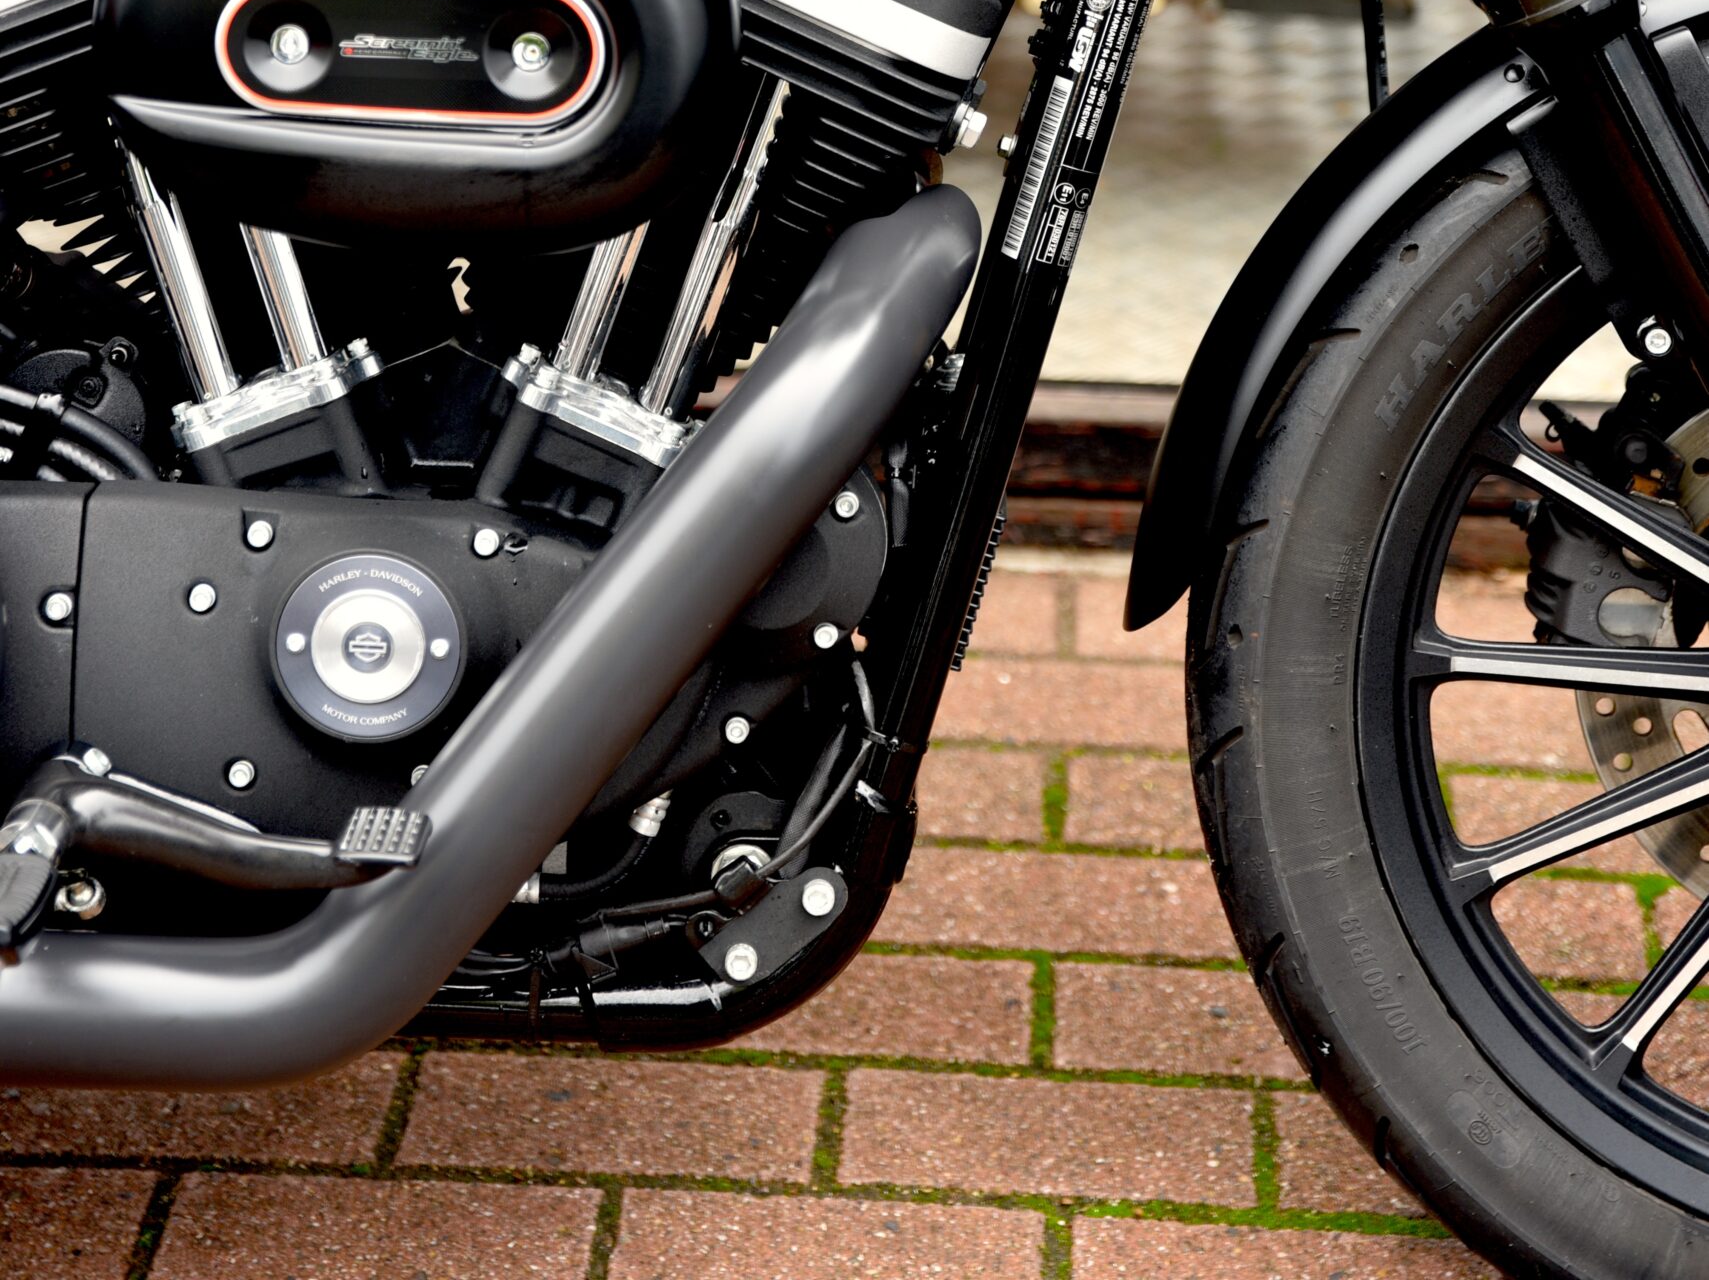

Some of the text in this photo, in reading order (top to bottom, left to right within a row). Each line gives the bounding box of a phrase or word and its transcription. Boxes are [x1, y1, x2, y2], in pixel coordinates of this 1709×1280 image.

[1115, 0, 1125, 12] kW
[1125, 2, 1134, 14] kW
[1104, 12, 1121, 47] VARIANT
[1114, 15, 1131, 49] VARIANT
[407, 47, 479, 63] Eagle
[1092, 58, 1106, 80] dB(A)
[1102, 61, 1116, 83] dB(A)
[1096, 88, 1107, 107] 3000
[1075, 104, 1092, 137] REV/MIN
[1085, 107, 1101, 140] REV/MIN
[1061, 184, 1072, 202] E11
[1374, 221, 1552, 434] HARLE
[318, 569, 362, 593] HARLEY
[370, 569, 423, 598] DAVIDSON
[321, 703, 408, 726] MOTOR COMPANY
